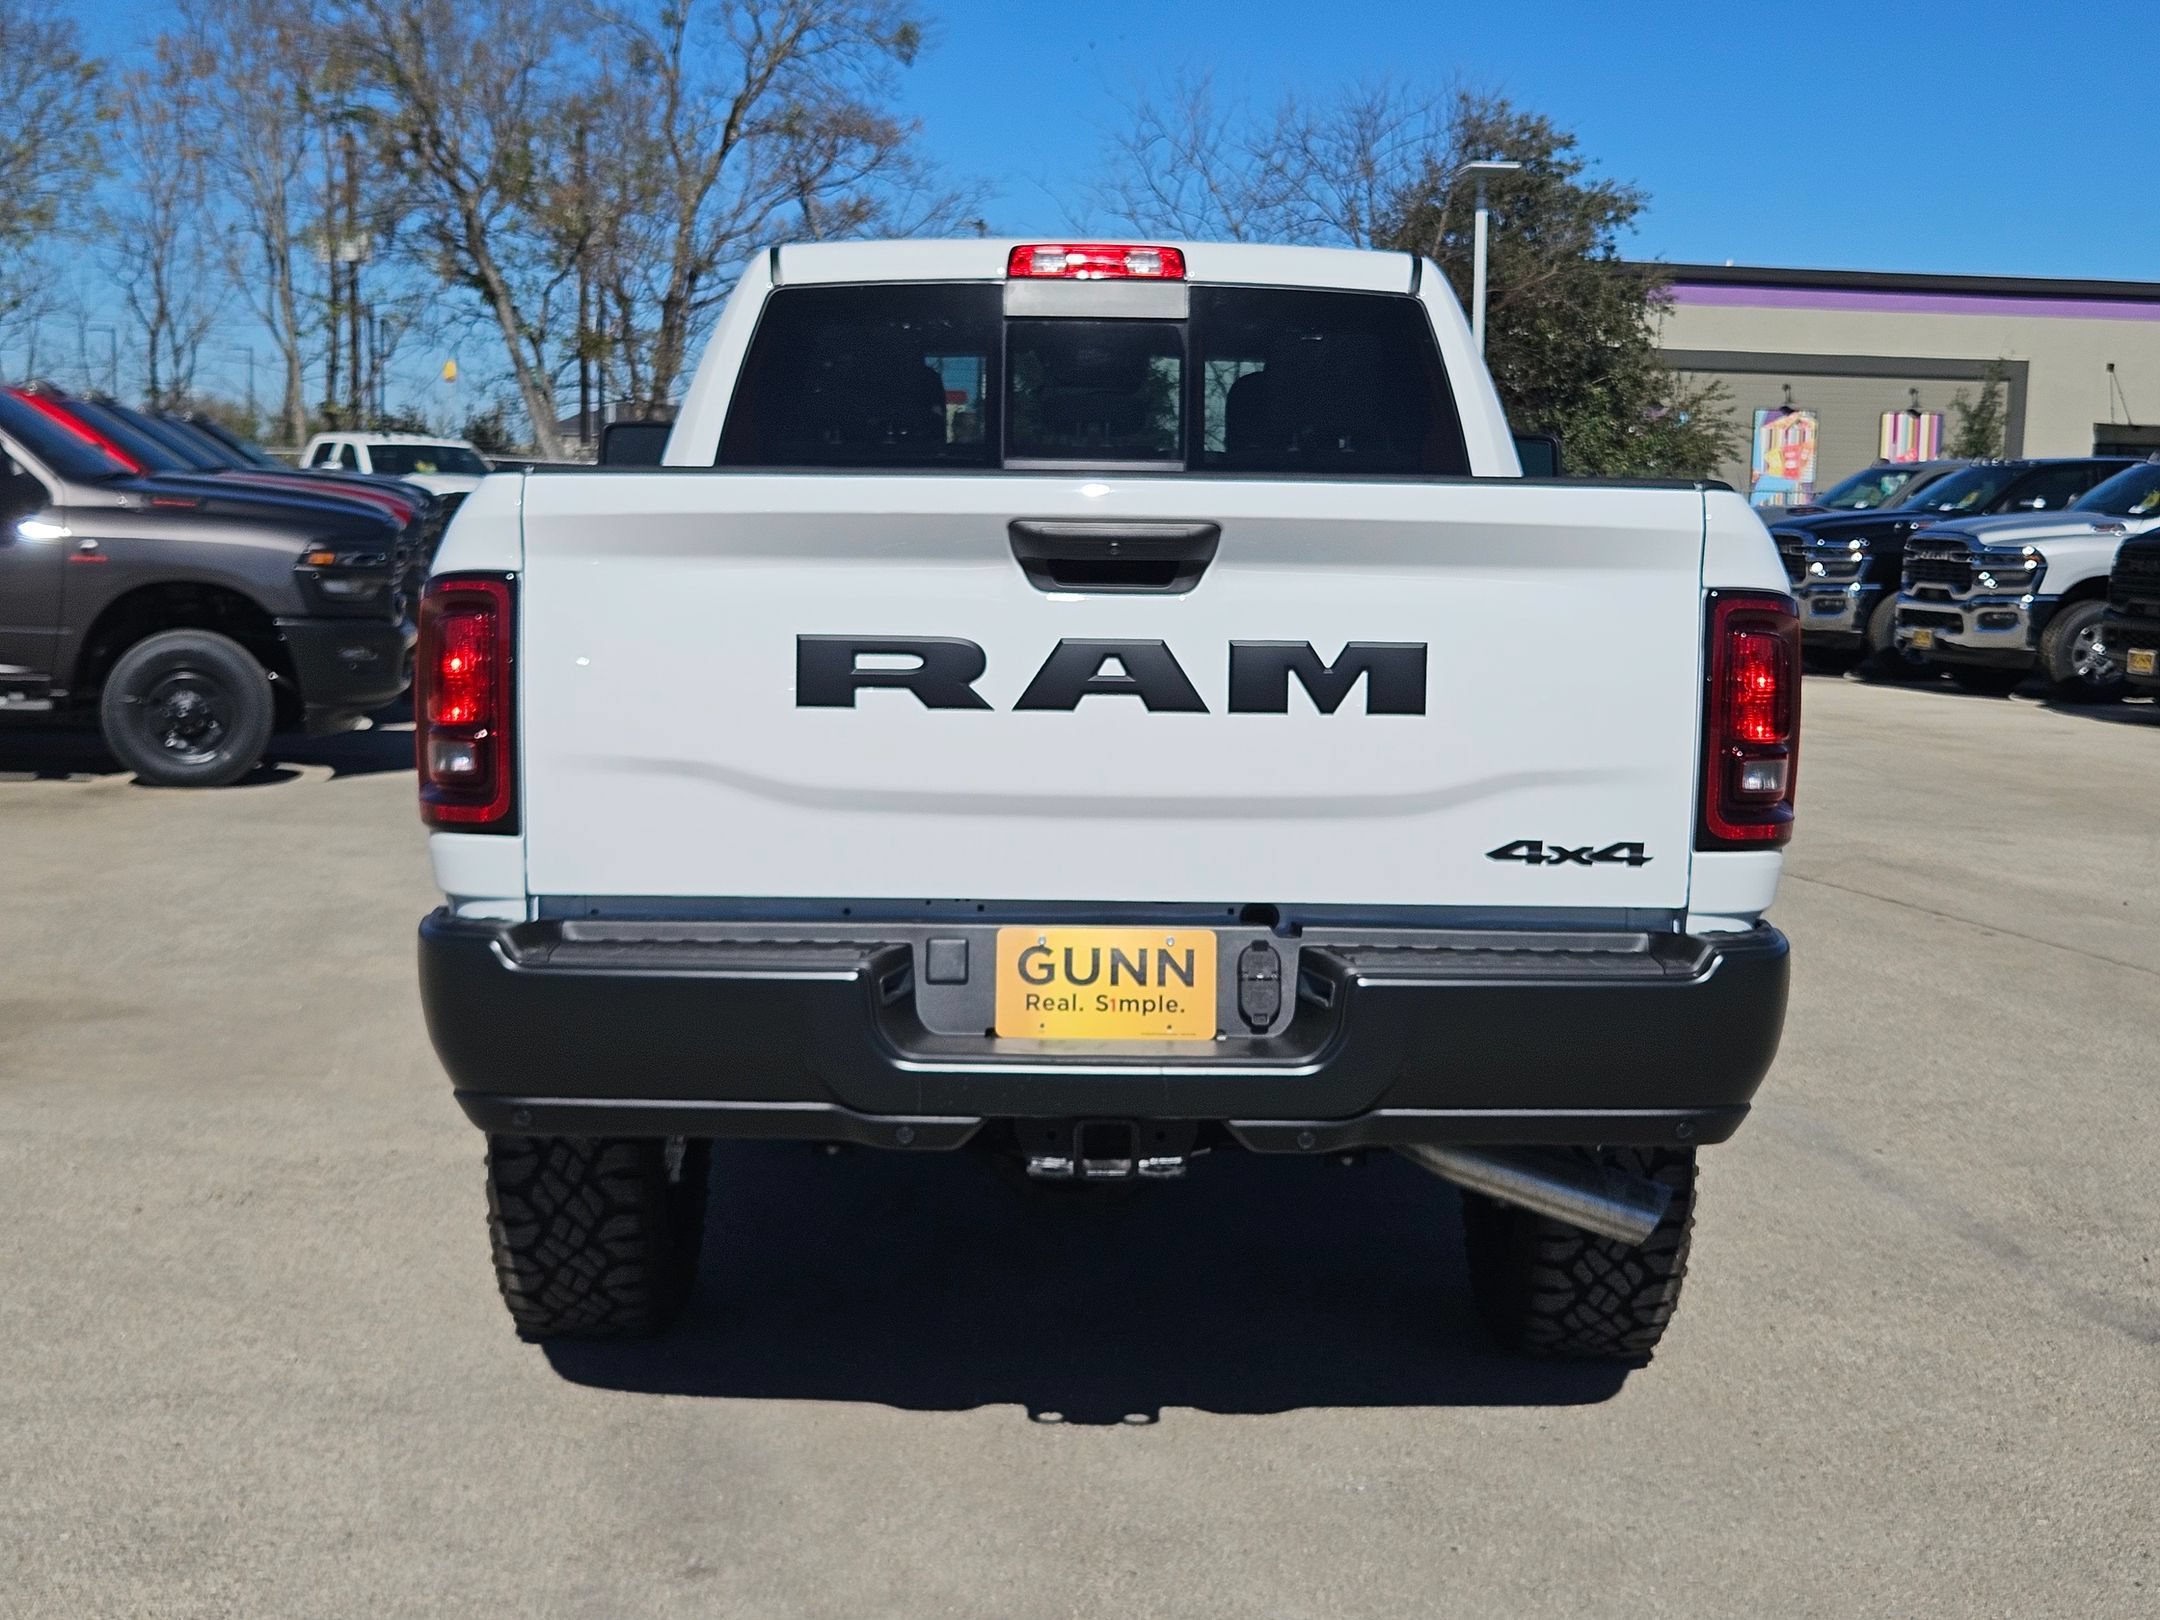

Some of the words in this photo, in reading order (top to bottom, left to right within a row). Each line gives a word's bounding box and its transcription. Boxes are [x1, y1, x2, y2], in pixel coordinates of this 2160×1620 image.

[796, 634, 1428, 716] RAM
[1485, 839, 1654, 867] 4x4
[1017, 945, 1195, 988] GUNN
[1025, 994, 1085, 1012] Real.
